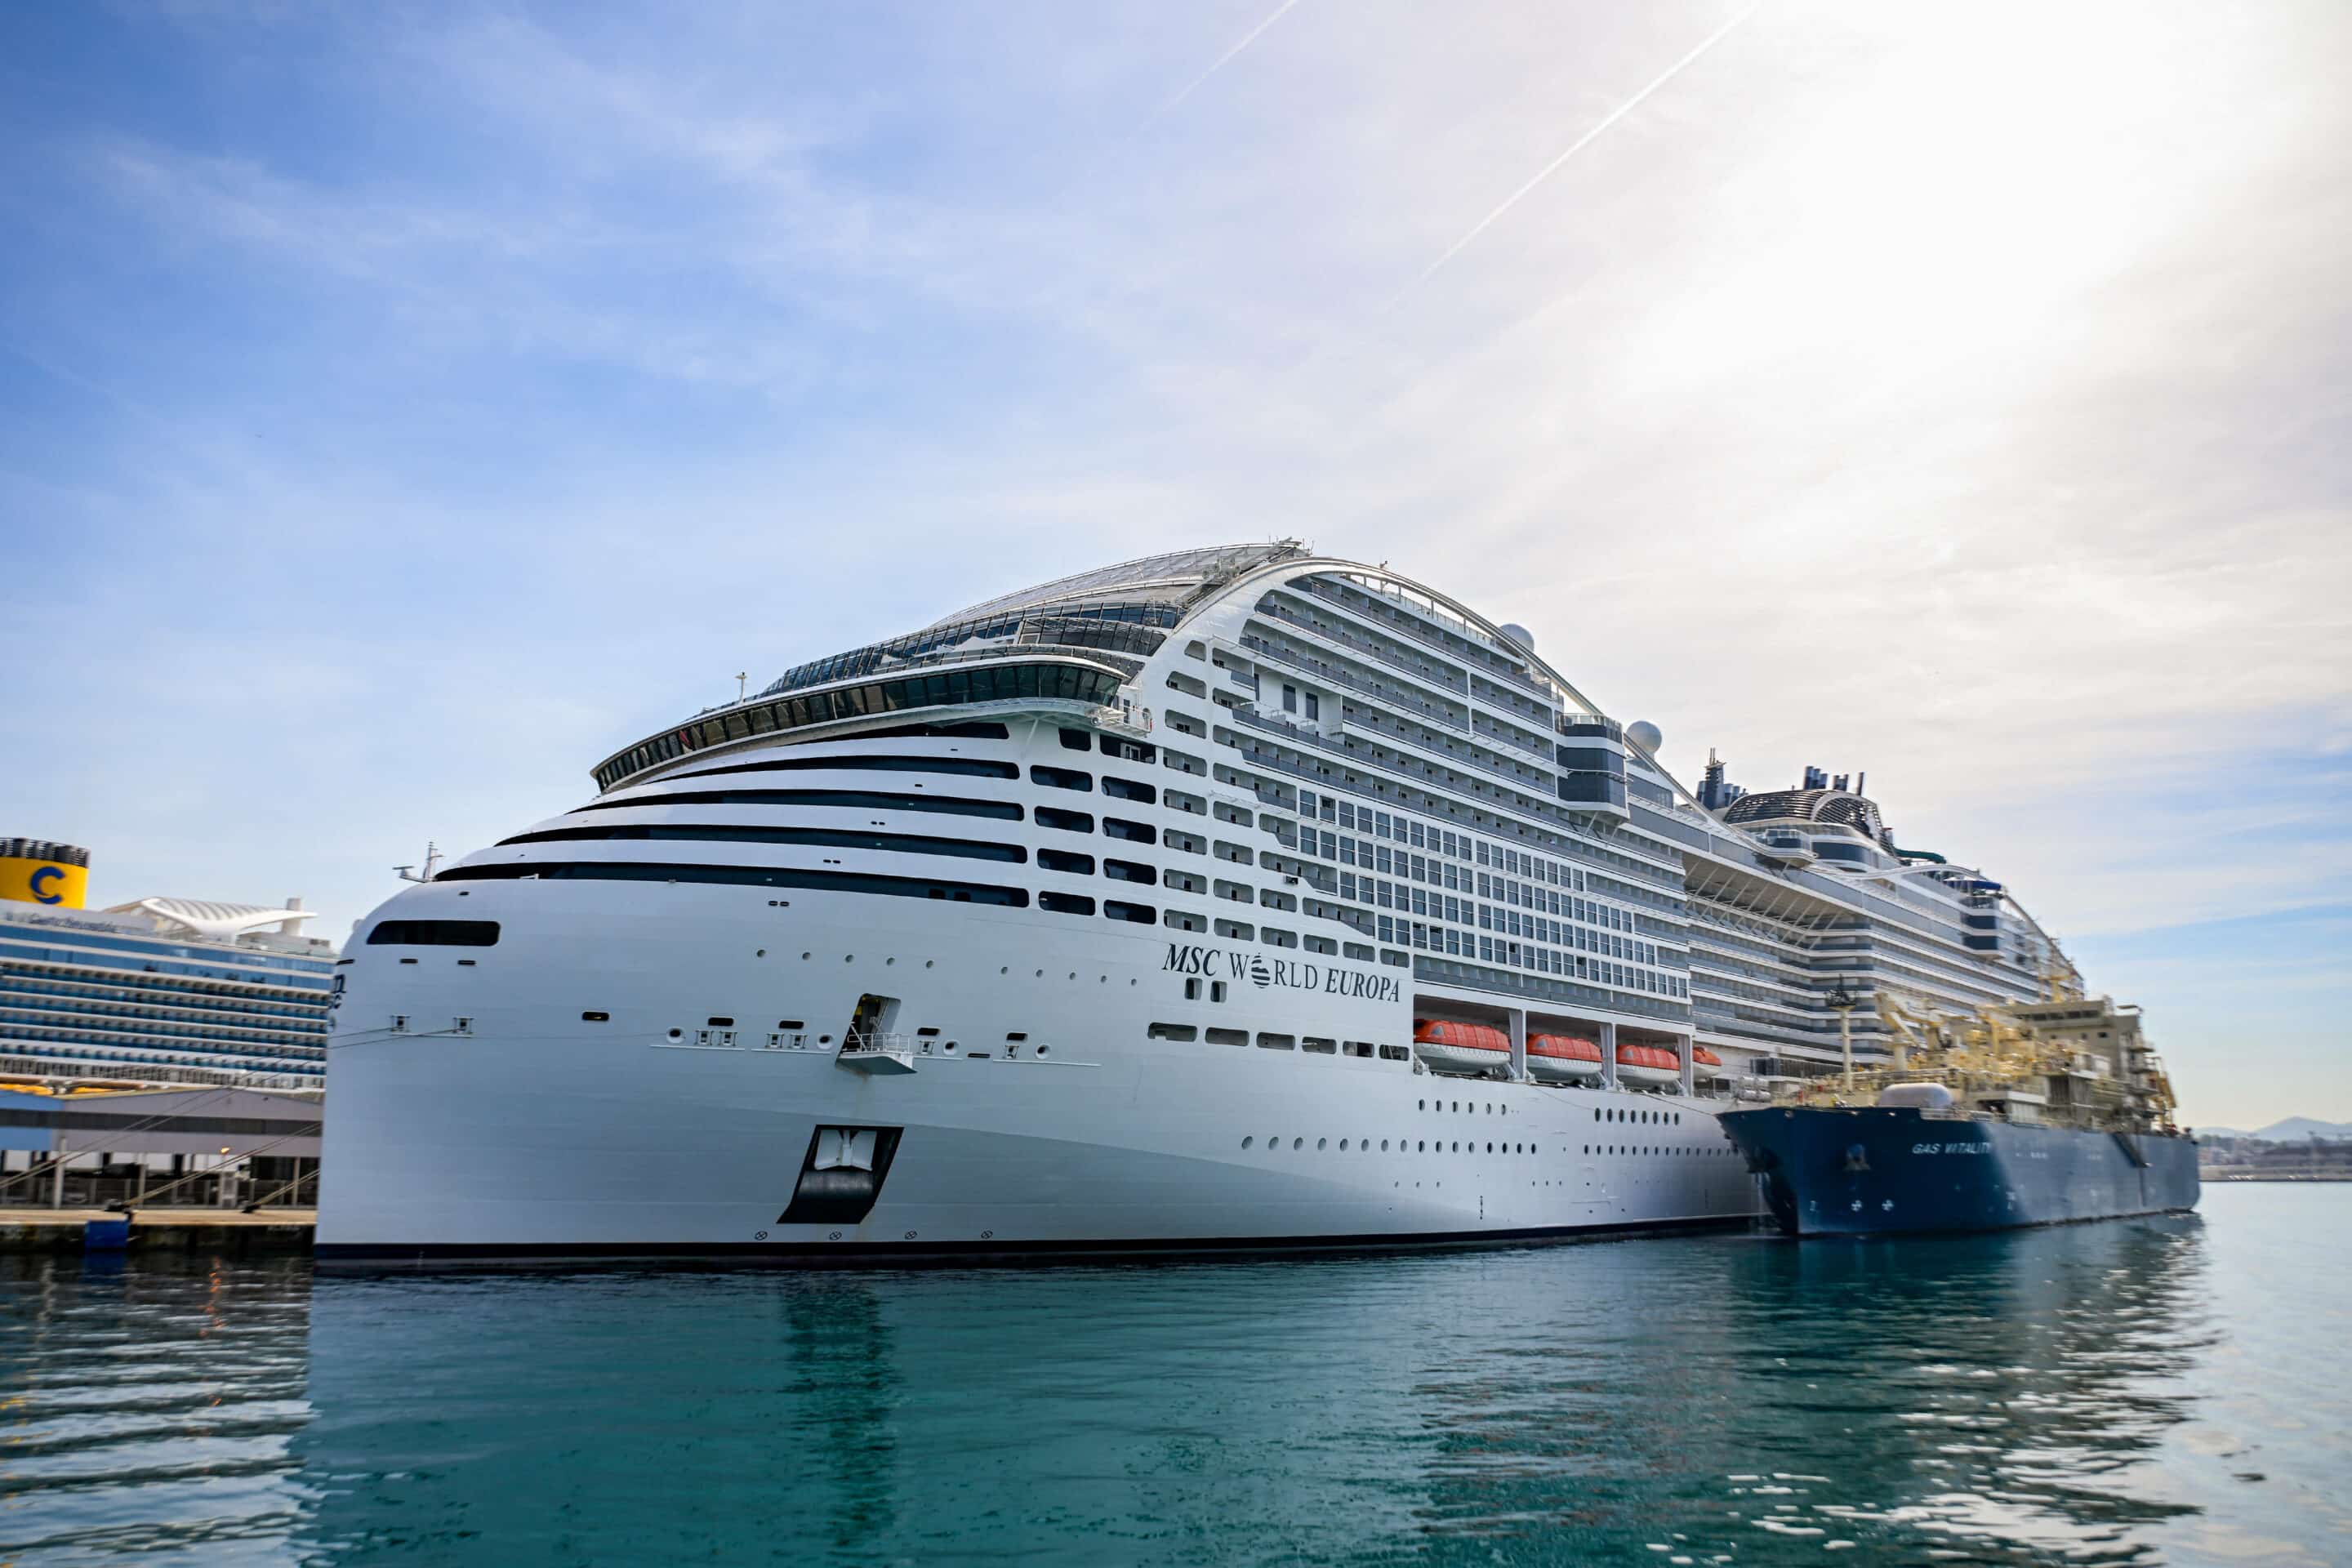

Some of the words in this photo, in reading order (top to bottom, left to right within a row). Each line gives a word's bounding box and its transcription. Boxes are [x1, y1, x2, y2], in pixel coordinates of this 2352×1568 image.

[1162, 943, 1220, 977] MSC
[1325, 968, 1399, 1002] EUROPA
[1912, 1143, 1940, 1155] GAS
